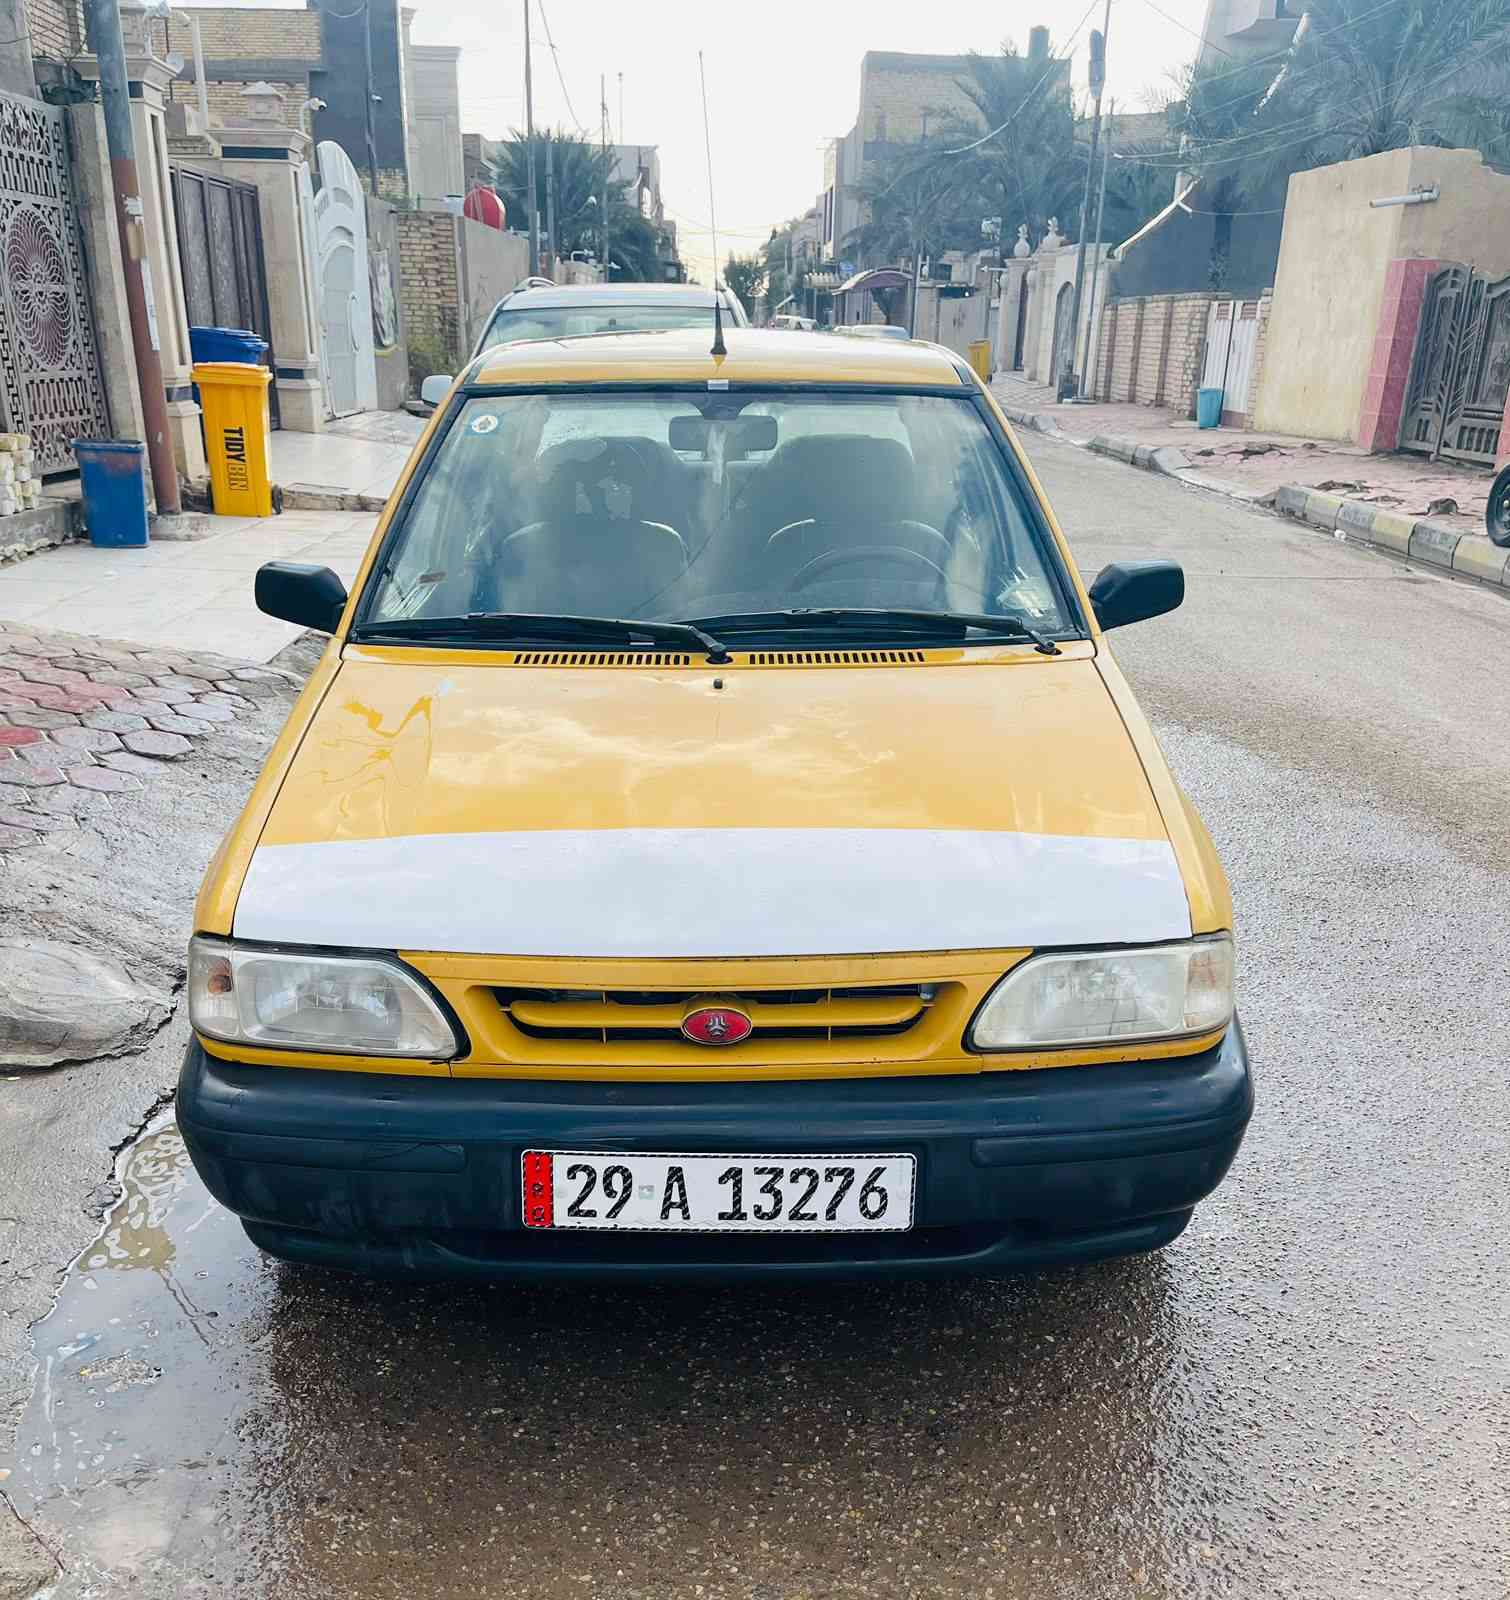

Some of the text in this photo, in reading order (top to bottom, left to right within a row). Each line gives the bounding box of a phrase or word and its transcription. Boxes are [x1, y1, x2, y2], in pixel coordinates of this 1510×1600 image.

[223, 427, 249, 491] TIDY BIN
[566, 1164, 889, 1221] 29 A 13276
